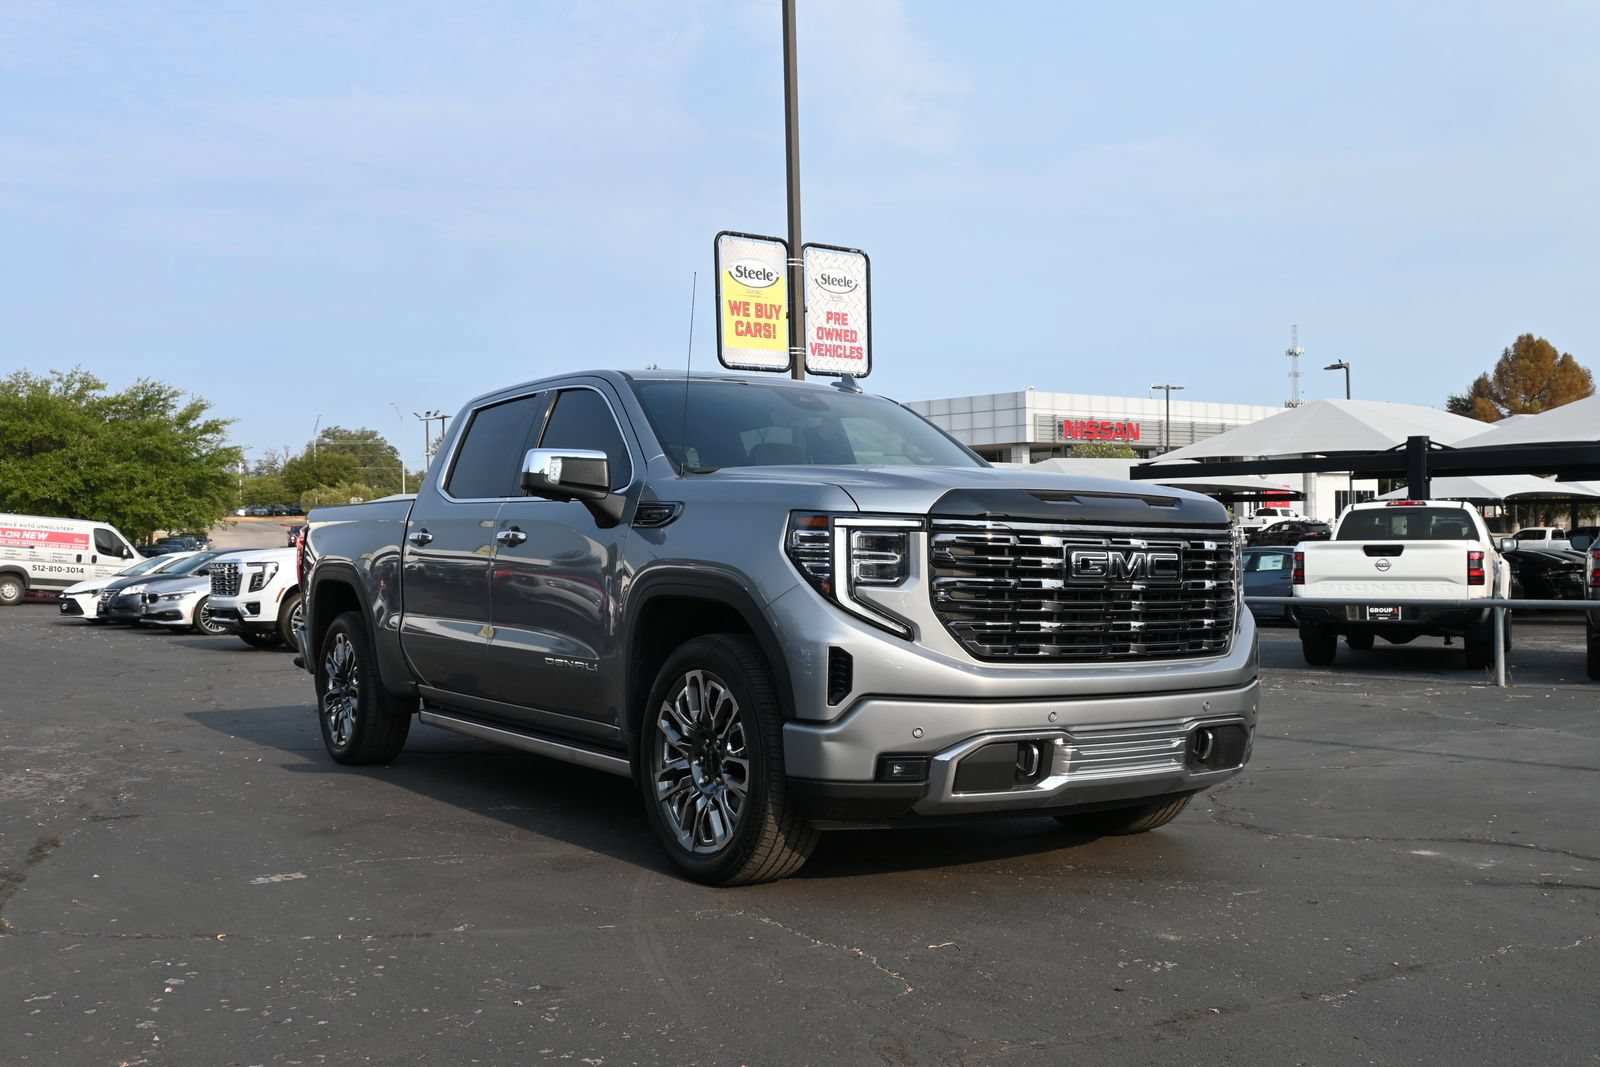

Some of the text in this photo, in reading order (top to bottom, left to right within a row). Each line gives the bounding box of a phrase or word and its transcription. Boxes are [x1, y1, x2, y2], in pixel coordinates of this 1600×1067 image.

[735, 264, 773, 282] Steele
[820, 273, 853, 288] Steele
[728, 300, 782, 320] WE BUY
[825, 311, 849, 326] PRE
[734, 320, 777, 340] CARS!
[816, 326, 858, 343] OWNED
[809, 342, 863, 360] VEHICLES
[1063, 419, 1140, 442] NISSAN
[21, 530, 48, 540] NEW
[32, 564, 84, 574] 512-810-3014
[1071, 551, 1178, 579] GMC
[1319, 582, 1453, 593] FRONTIER
[544, 657, 598, 672] DENALI
